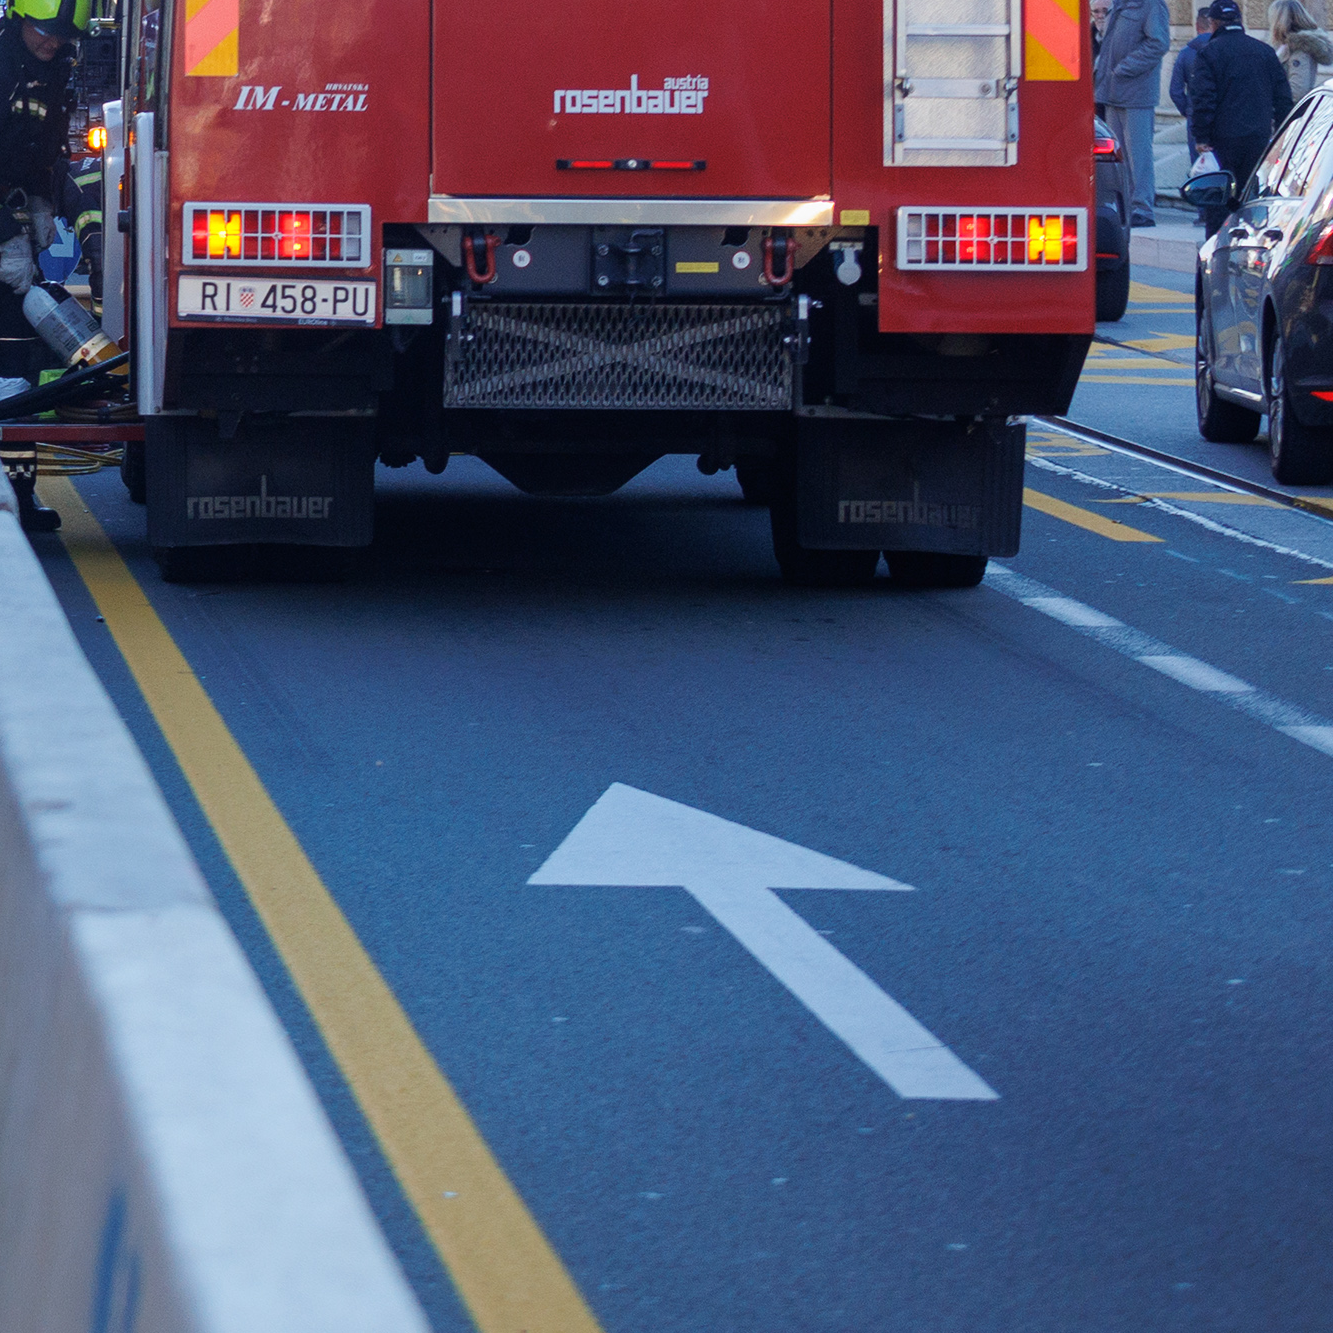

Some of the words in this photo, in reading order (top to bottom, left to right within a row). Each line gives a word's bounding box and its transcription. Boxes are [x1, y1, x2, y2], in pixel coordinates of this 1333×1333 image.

[233, 86, 282, 110] IM
[291, 93, 369, 112] METAL
[553, 74, 709, 114] rosenbauer
[663, 74, 709, 90] austria
[201, 282, 231, 312] RI
[260, 284, 370, 317] 458-PU
[186, 474, 333, 519] rosenbauer
